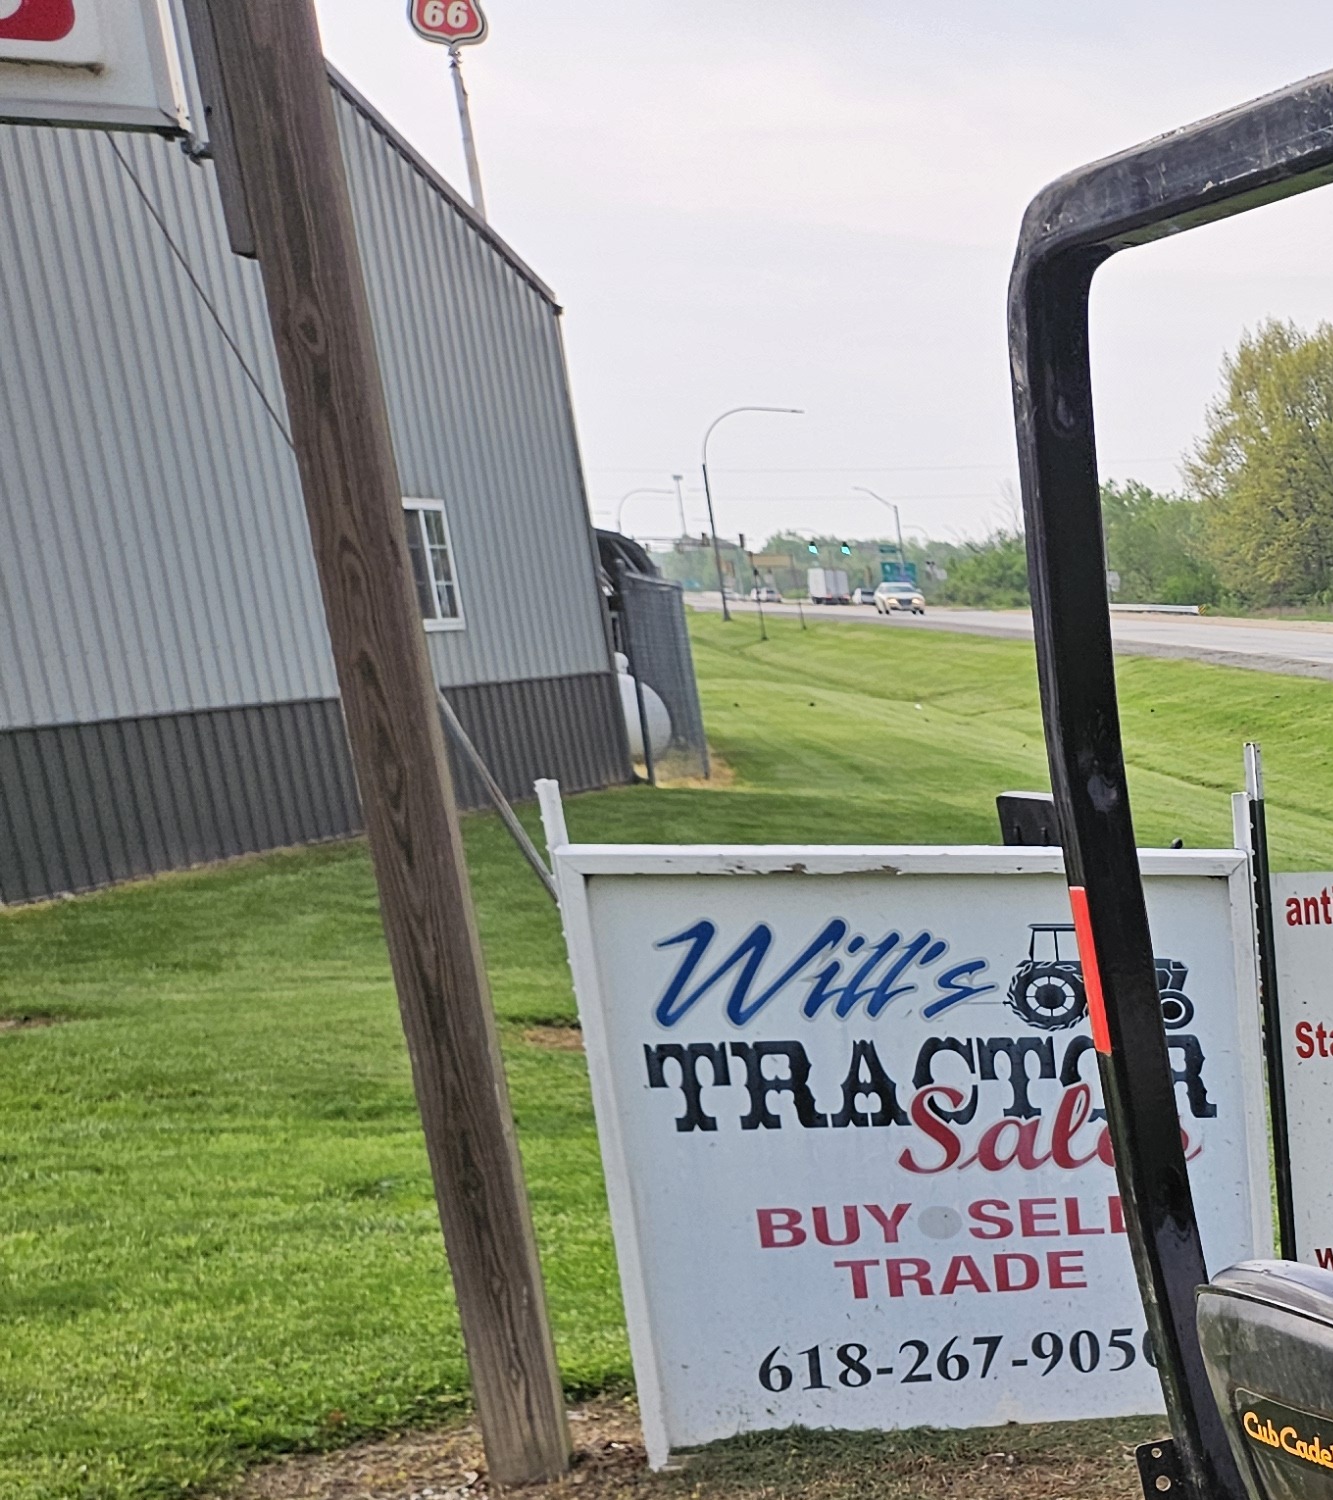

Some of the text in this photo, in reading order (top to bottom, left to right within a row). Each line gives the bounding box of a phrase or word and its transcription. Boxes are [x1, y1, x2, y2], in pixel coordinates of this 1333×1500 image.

[423, 0, 468, 29] 66
[655, 918, 995, 1028] Will's
[755, 1202, 912, 1249] BUY
[834, 1250, 1088, 1299] TRADE
[1243, 1411, 1280, 1448] Cub
